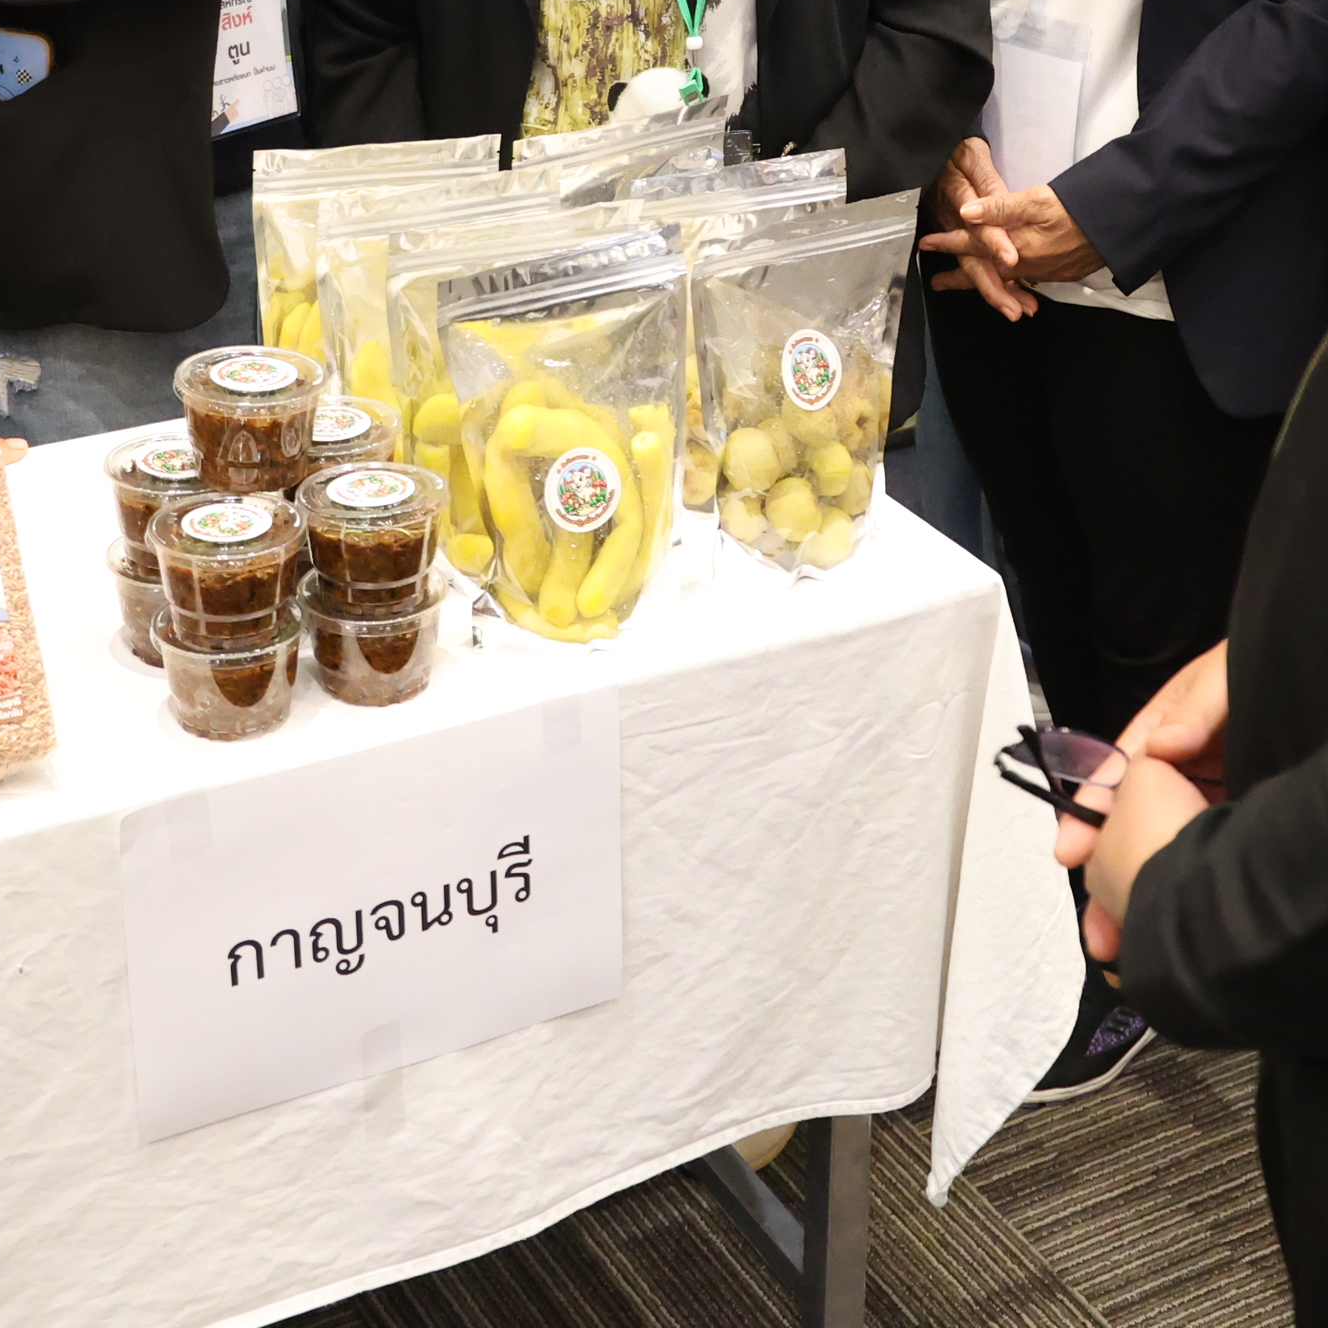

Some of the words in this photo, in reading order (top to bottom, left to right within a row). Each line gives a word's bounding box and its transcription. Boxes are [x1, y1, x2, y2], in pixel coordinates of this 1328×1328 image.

[227, 40, 251, 65] ตูน
[226, 833, 534, 988] กาญจนบุรี
